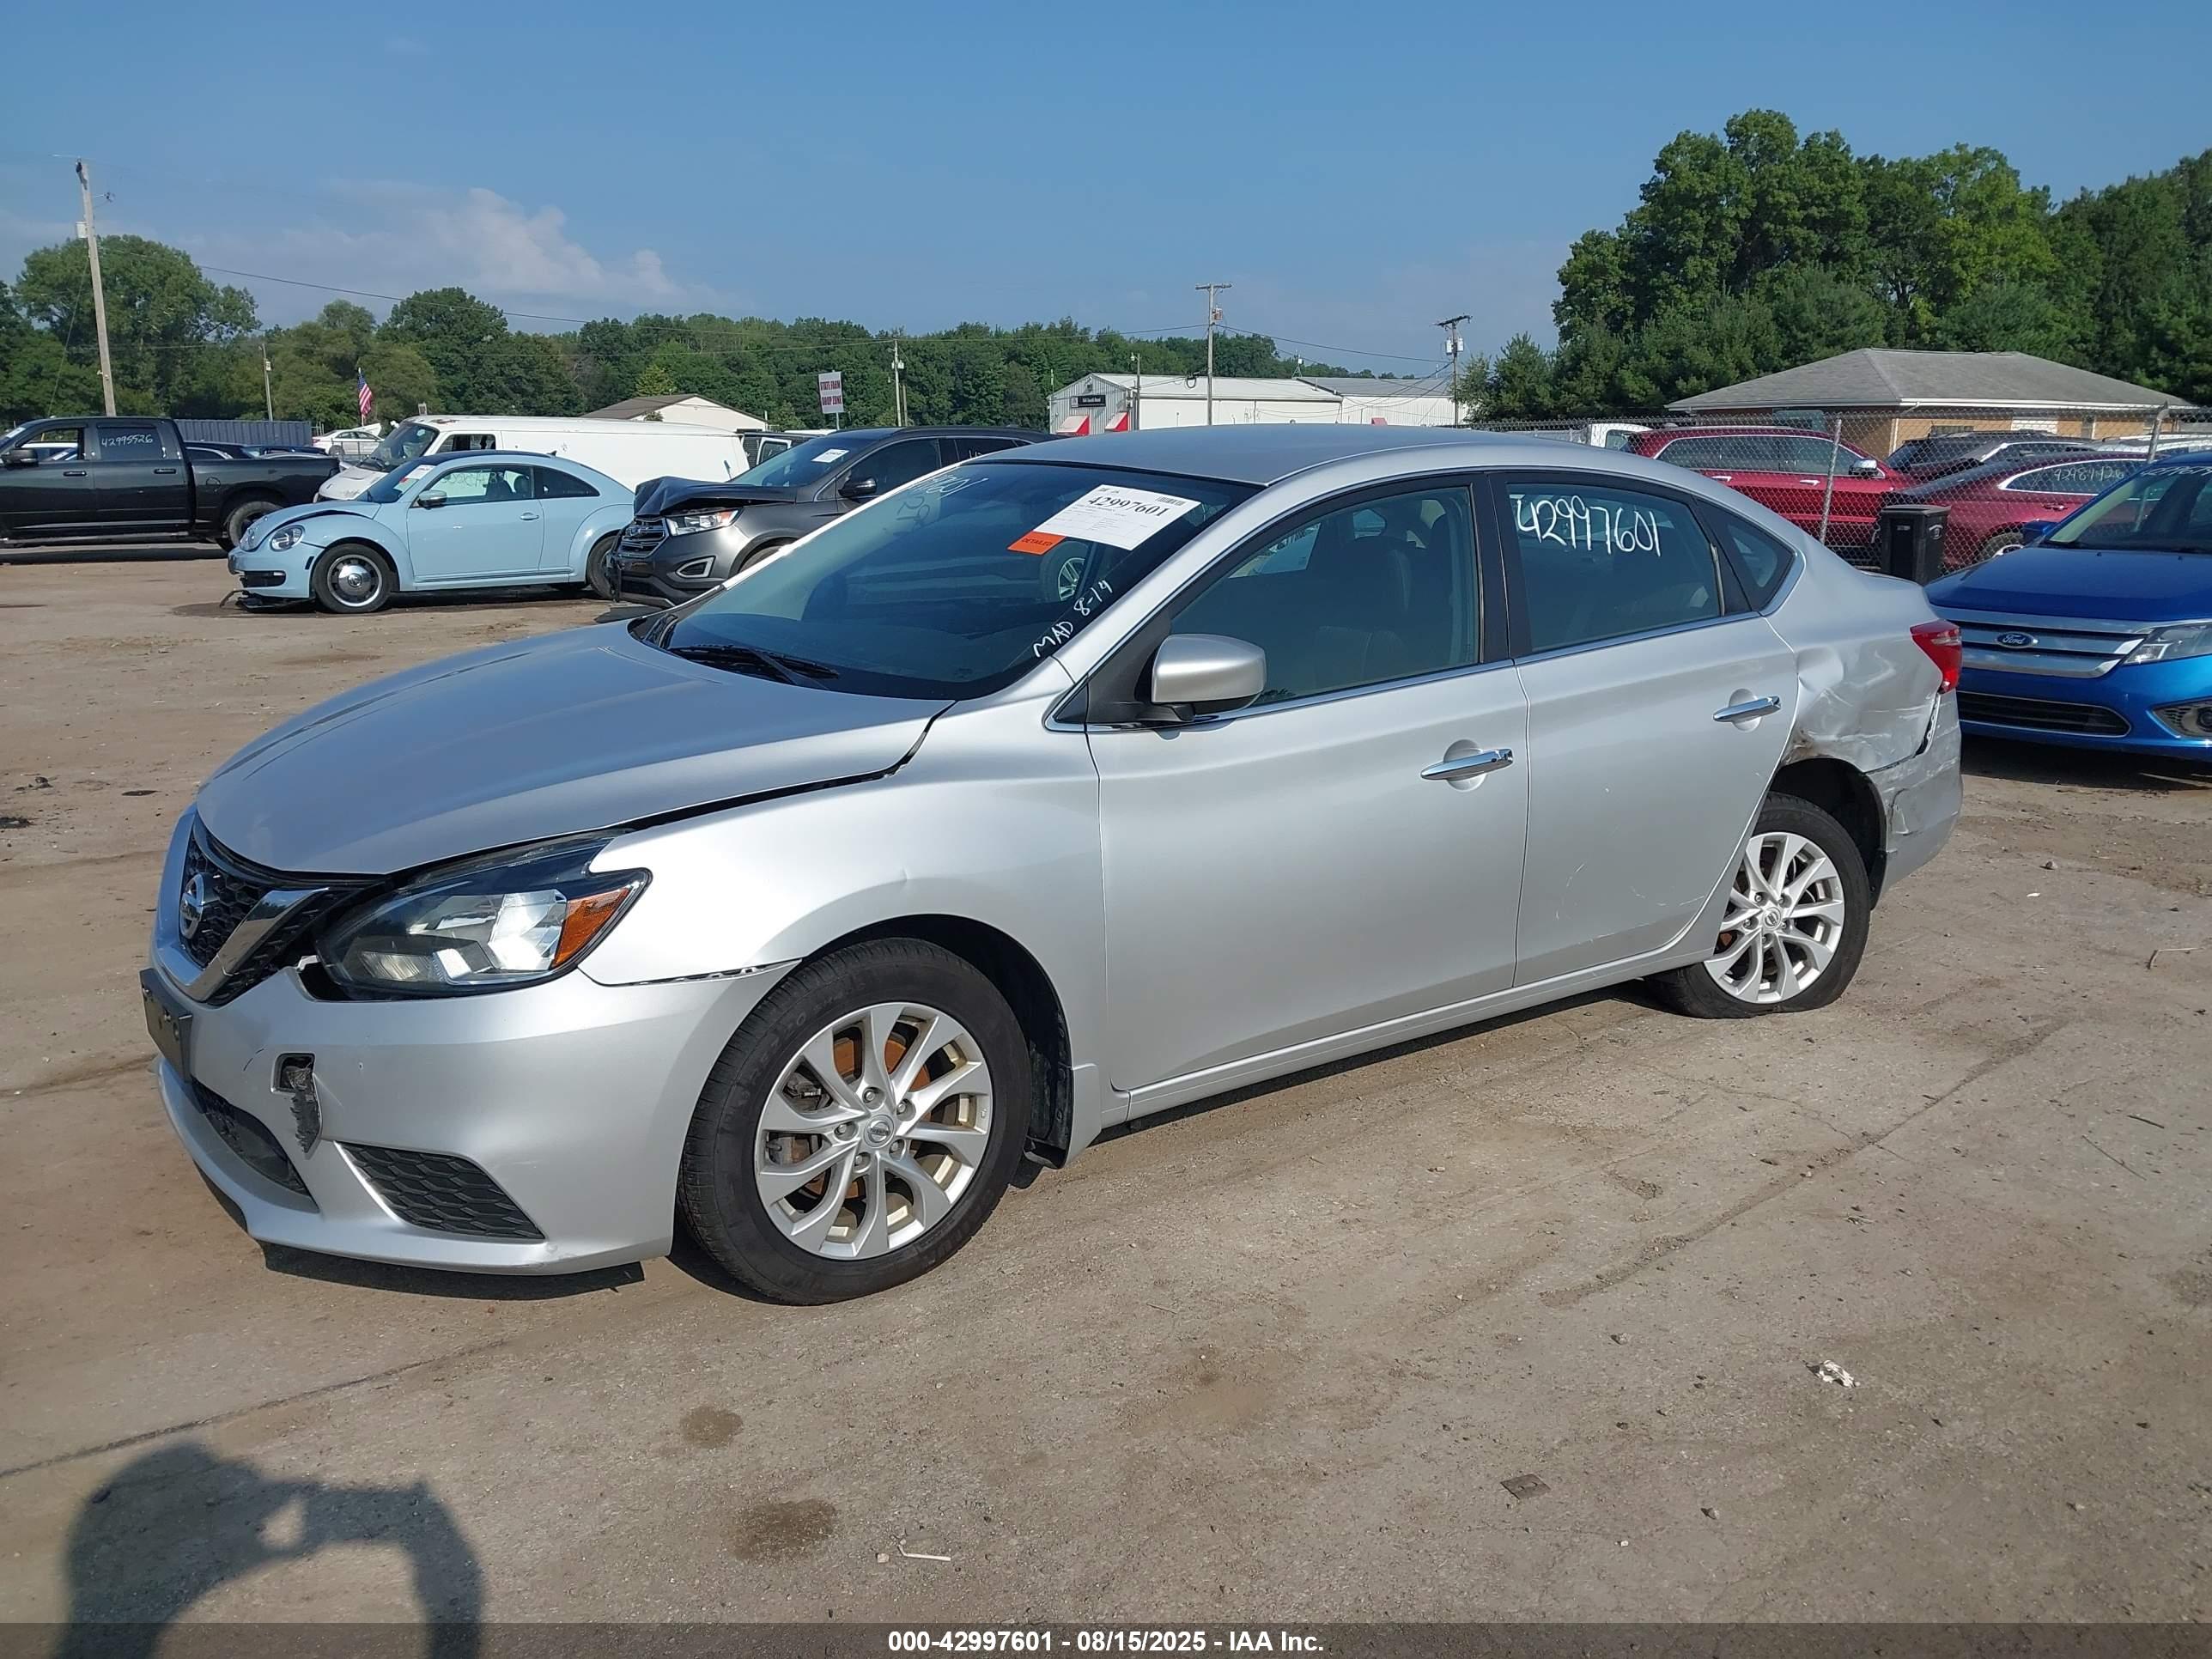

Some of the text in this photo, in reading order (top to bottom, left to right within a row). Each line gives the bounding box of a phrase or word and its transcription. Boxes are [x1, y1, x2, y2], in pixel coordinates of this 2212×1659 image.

[1088, 496, 1170, 517] 42997601
[1516, 495, 1662, 557] 42997601
[1033, 621, 1073, 658] MAD
[2002, 634, 2026, 644] Ford
